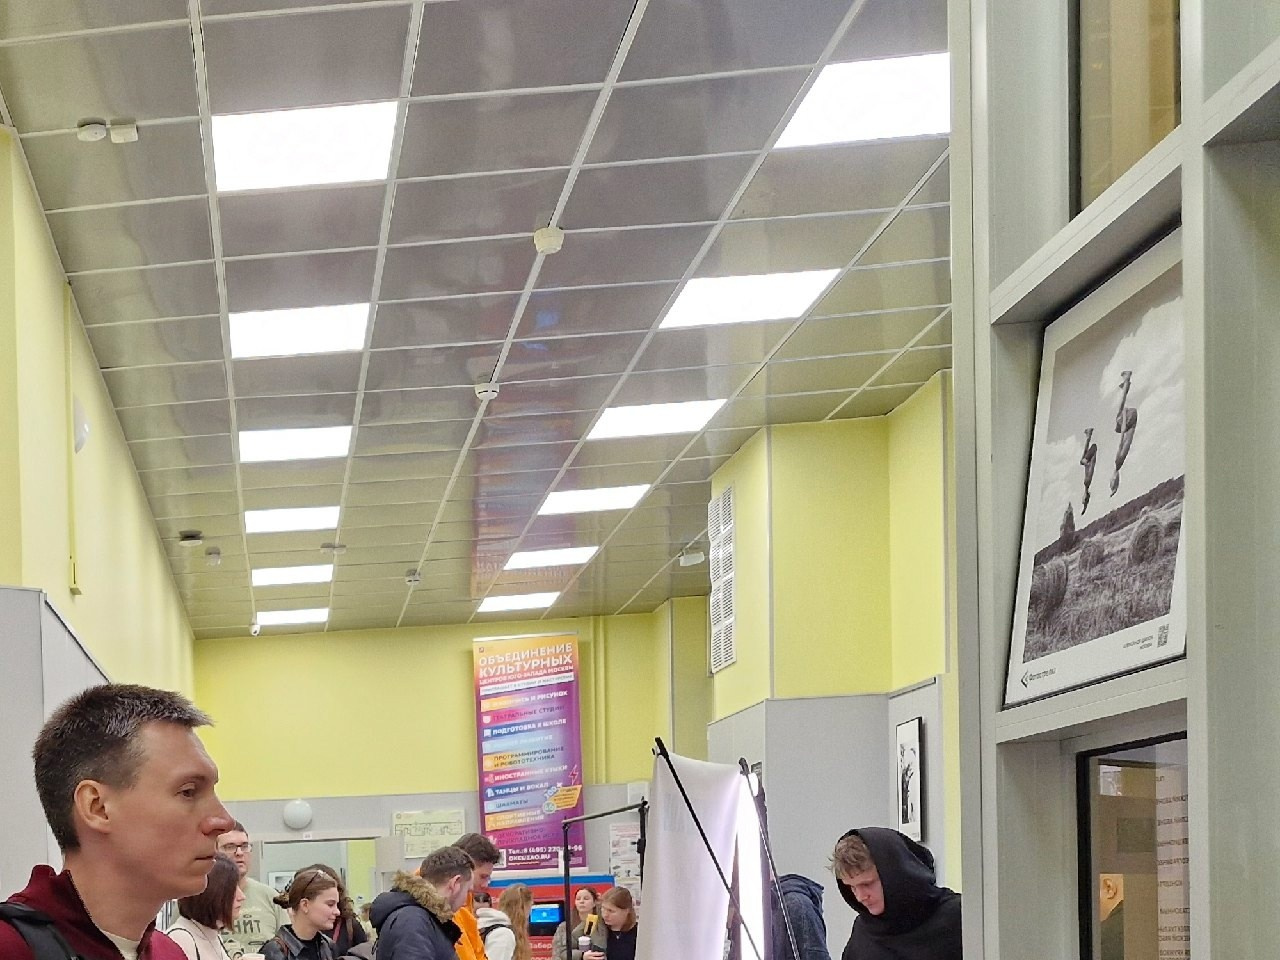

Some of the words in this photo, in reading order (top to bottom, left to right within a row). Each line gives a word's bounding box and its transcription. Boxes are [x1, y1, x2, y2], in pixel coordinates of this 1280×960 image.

[480, 643, 573, 666] ОБЪЕДИНЕНИЕ
[480, 653, 573, 678] КУЛЬТУРНЫХ
[548, 665, 574, 673] МОСКВЫ
[537, 690, 568, 701] РИСУНОК
[493, 723, 537, 735] ПОДГОТОВКА
[543, 718, 567, 728] ШКОЛЕ
[493, 746, 565, 761] ПРОГРАММИРОВАНИЕ
[500, 754, 555, 767] РОБОТОТЕХНИКА
[495, 786, 519, 795] ТАНЦЫ
[526, 782, 549, 791] ВОКАЛ
[496, 799, 529, 809] ШАХМАТЫ
